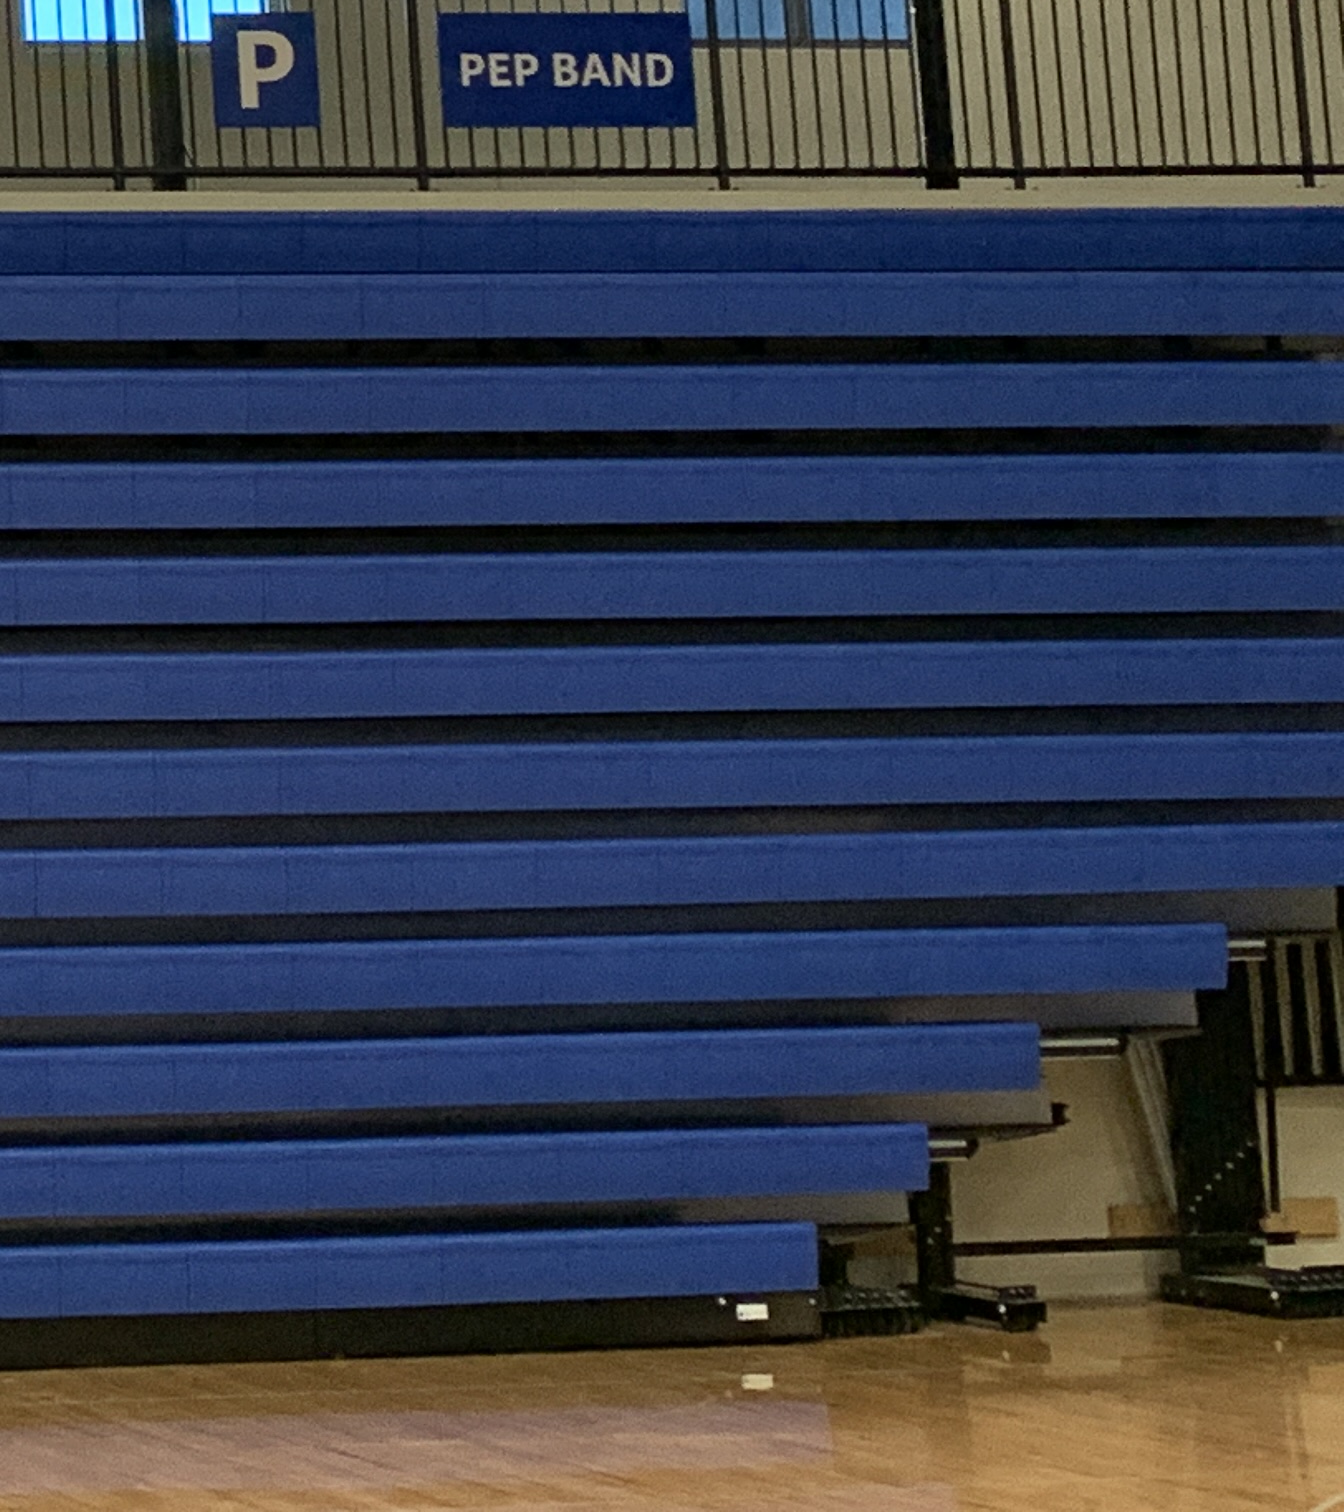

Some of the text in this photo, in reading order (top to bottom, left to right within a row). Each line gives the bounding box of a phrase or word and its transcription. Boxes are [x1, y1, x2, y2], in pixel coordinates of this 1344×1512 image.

[236, 29, 295, 110] P
[459, 52, 675, 88] PEP BAND
